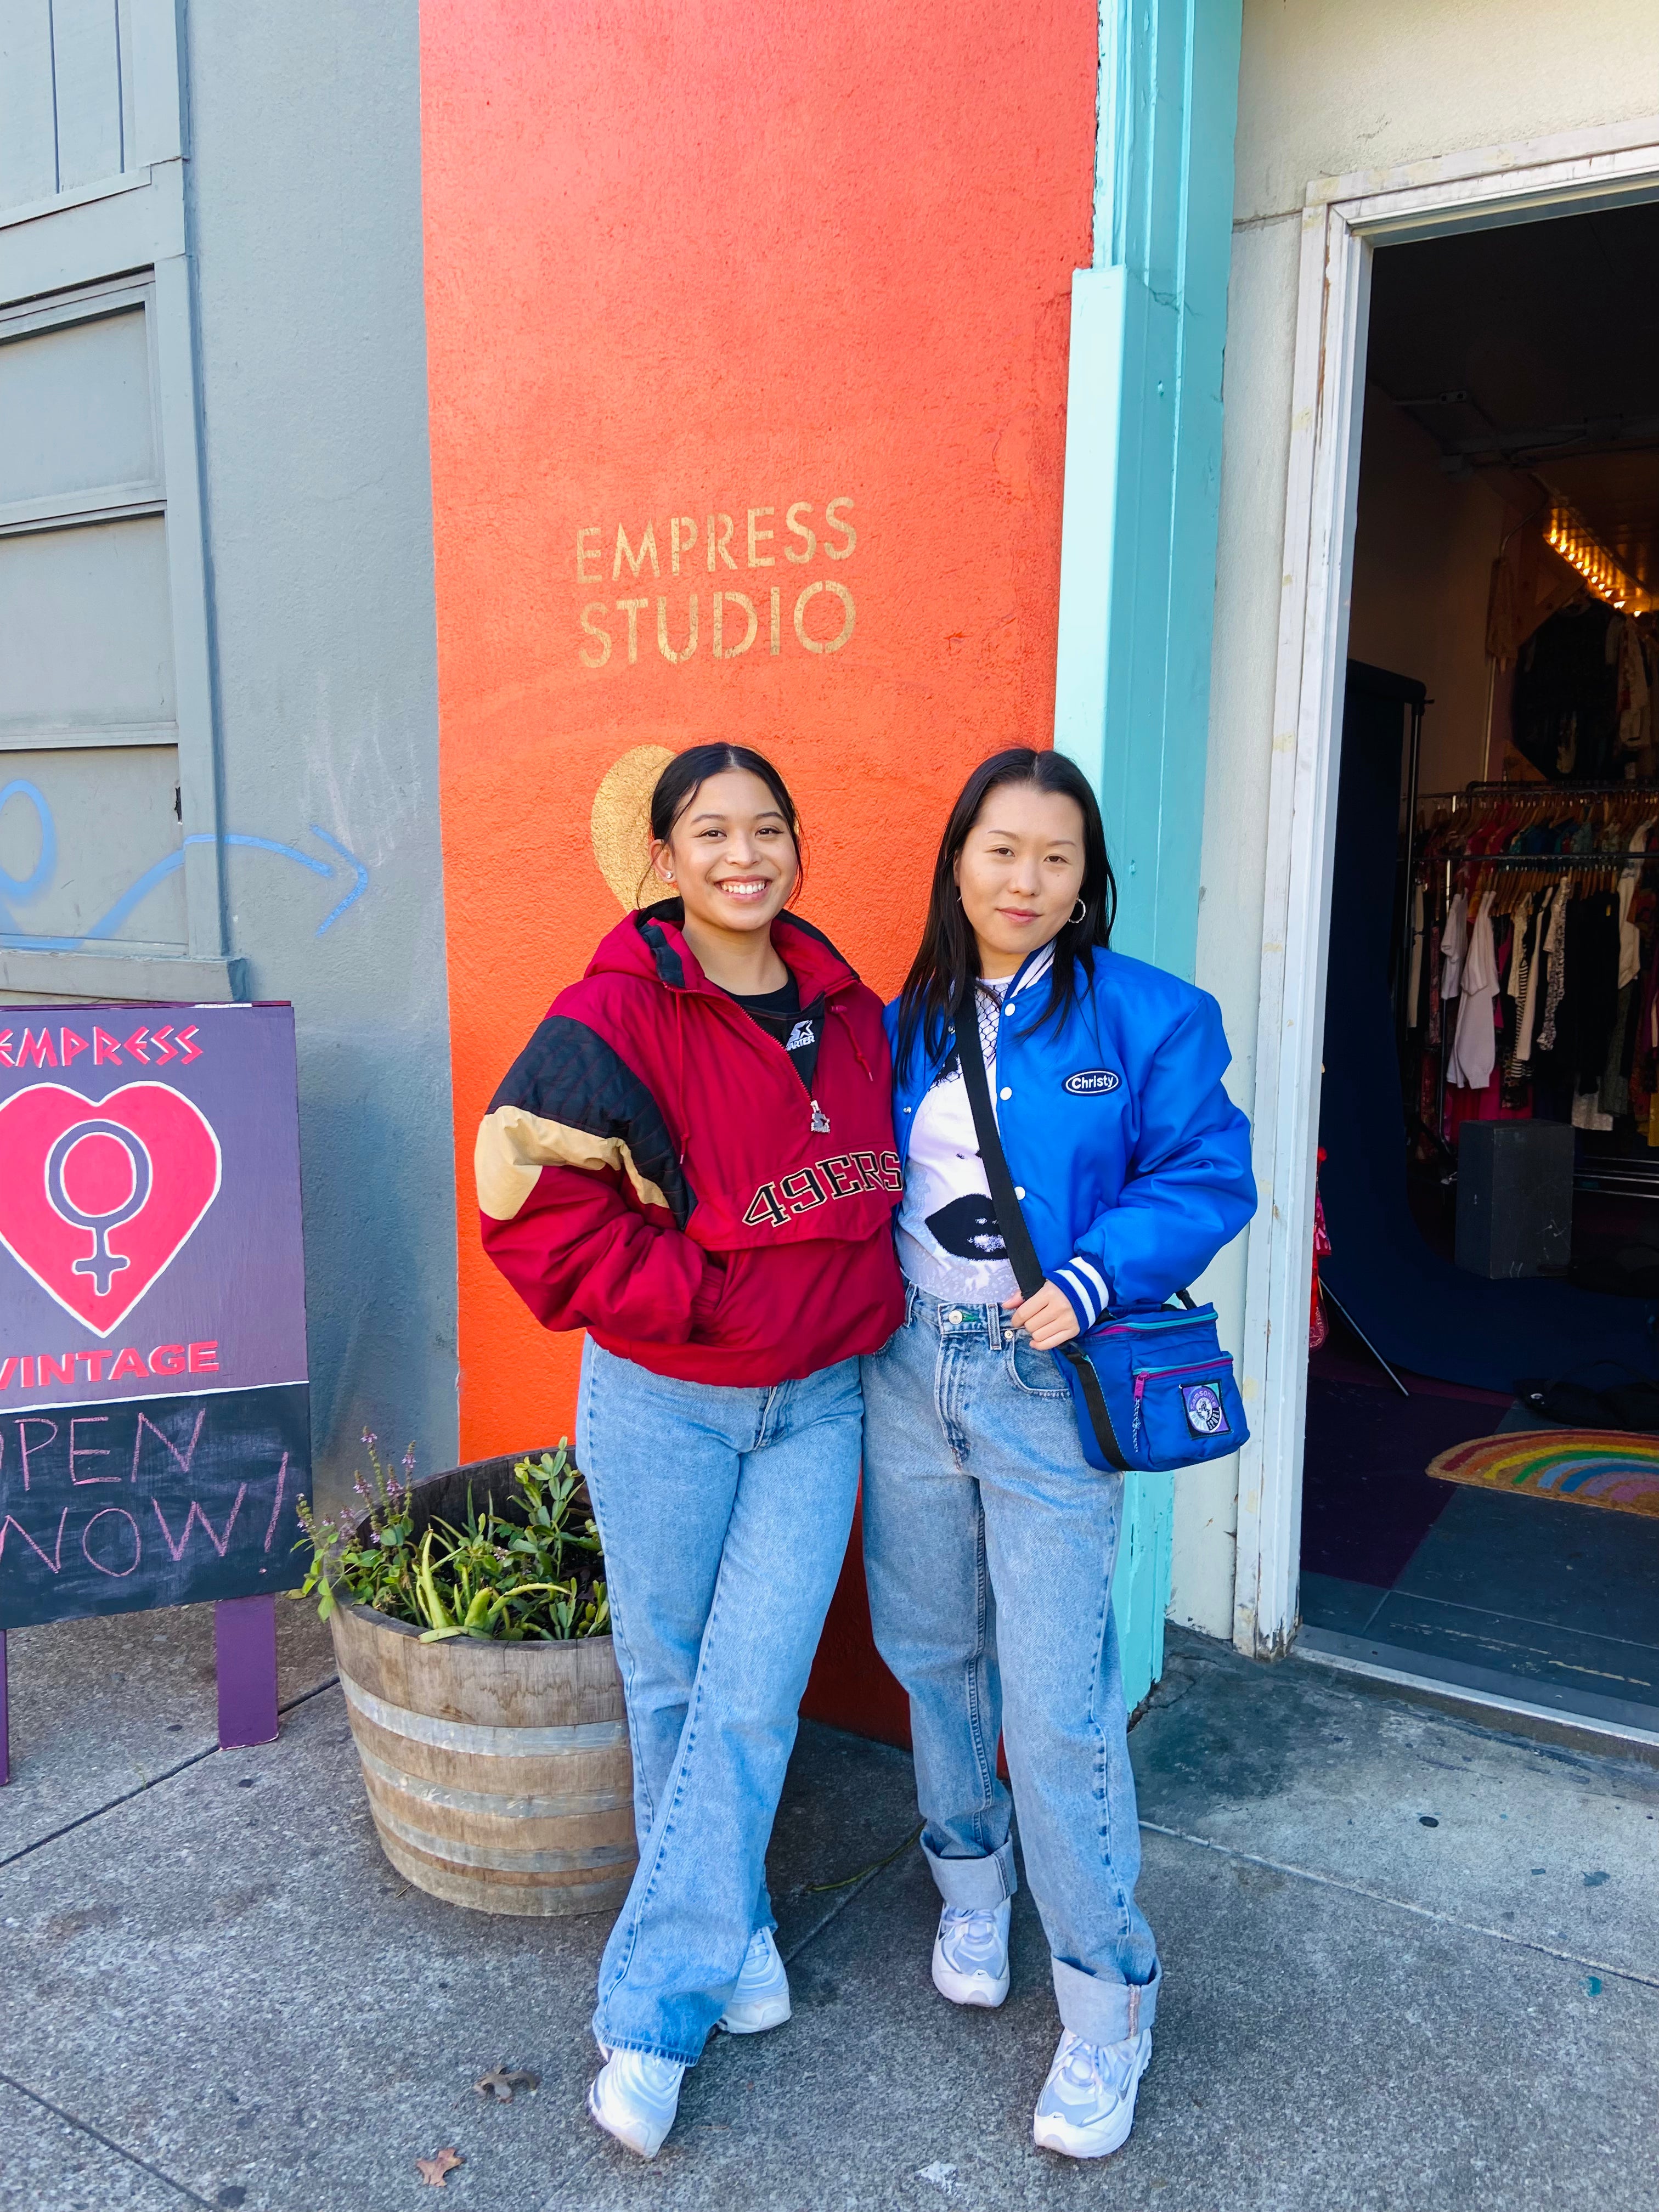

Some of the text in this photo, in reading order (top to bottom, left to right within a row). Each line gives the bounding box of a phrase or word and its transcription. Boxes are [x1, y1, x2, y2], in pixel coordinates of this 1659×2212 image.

[577, 496, 857, 584] EMPRESS
[579, 579, 857, 669] STUDIO
[0, 1024, 204, 1068] EMPRESS
[1071, 1075, 1114, 1090] Christy
[742, 1150, 904, 1228] 49ERS
[0, 1408, 206, 1492] PEN
